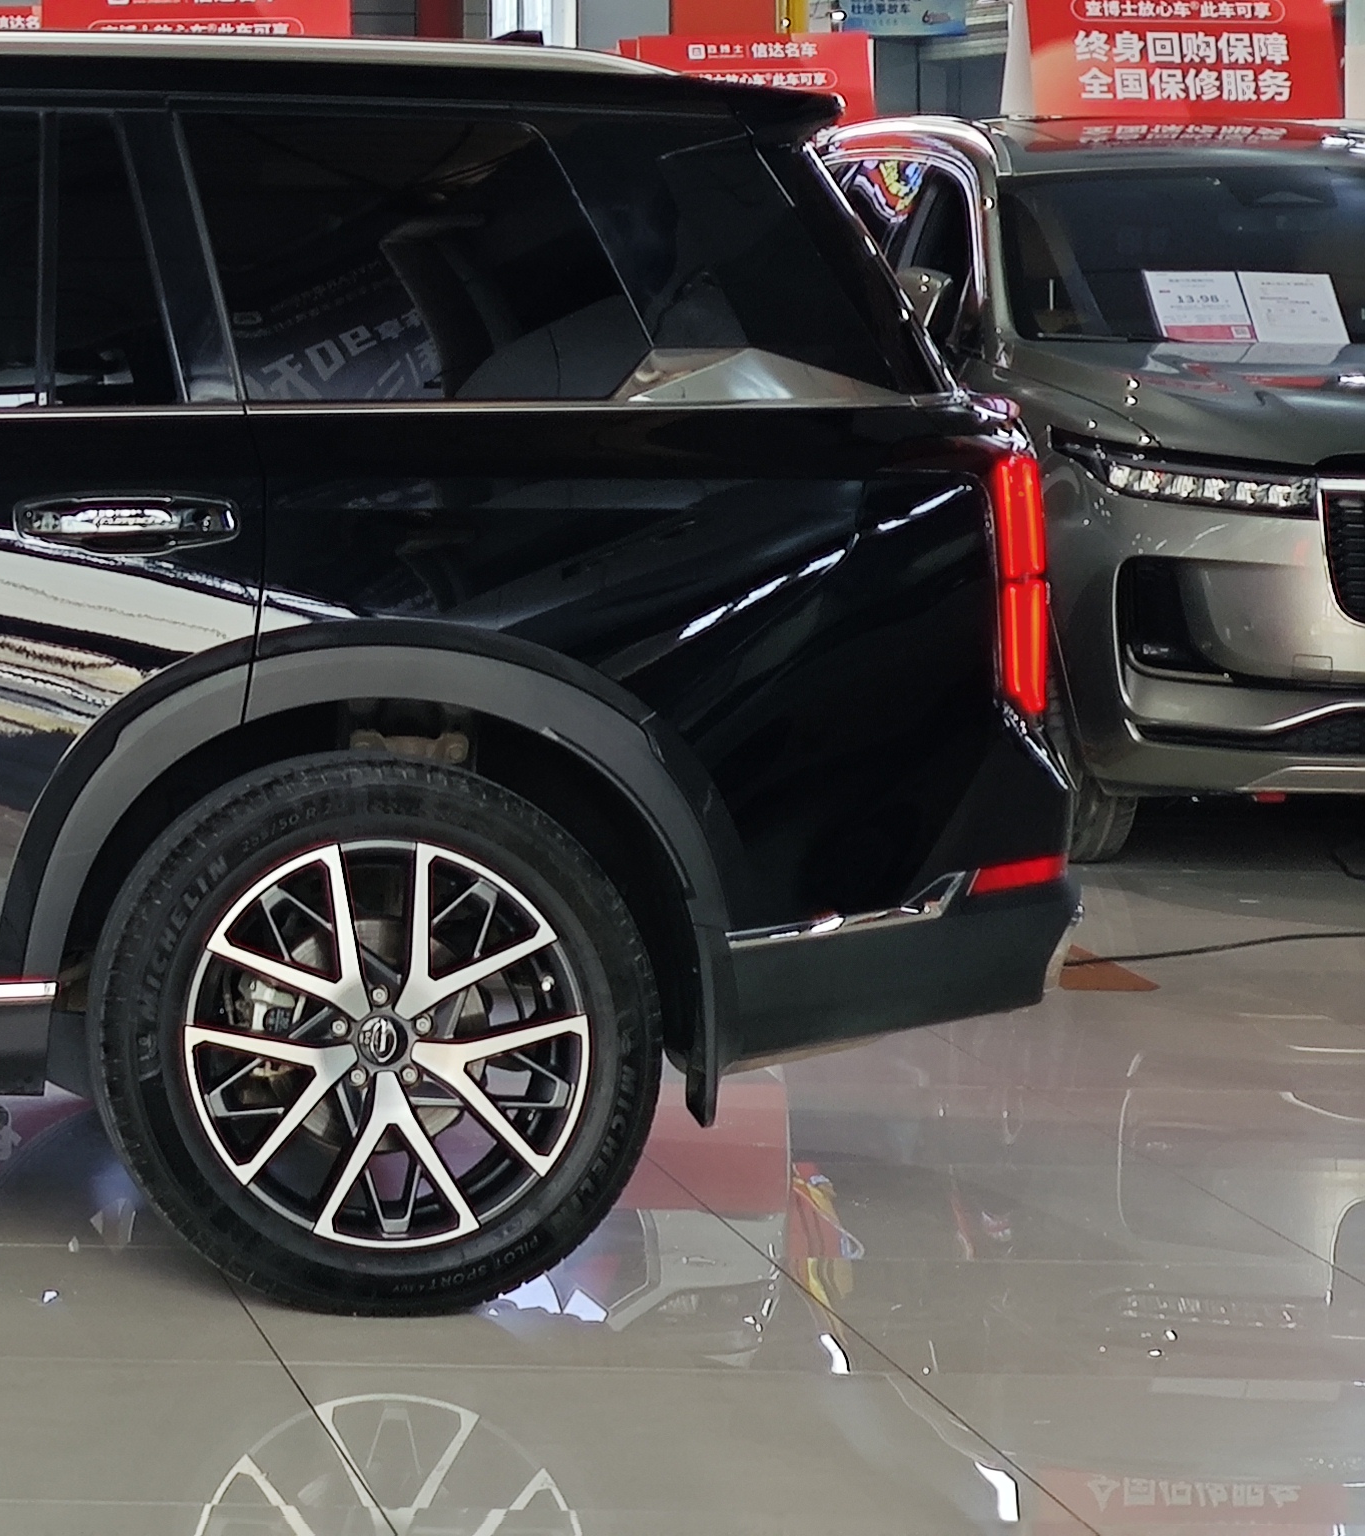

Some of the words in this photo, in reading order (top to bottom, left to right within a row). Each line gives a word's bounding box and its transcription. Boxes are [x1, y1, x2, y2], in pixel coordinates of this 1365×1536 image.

[751, 41, 818, 59] 信达名车
[1073, 30, 1291, 65] 终身回购保障
[1078, 67, 1293, 103] 全国保修服务
